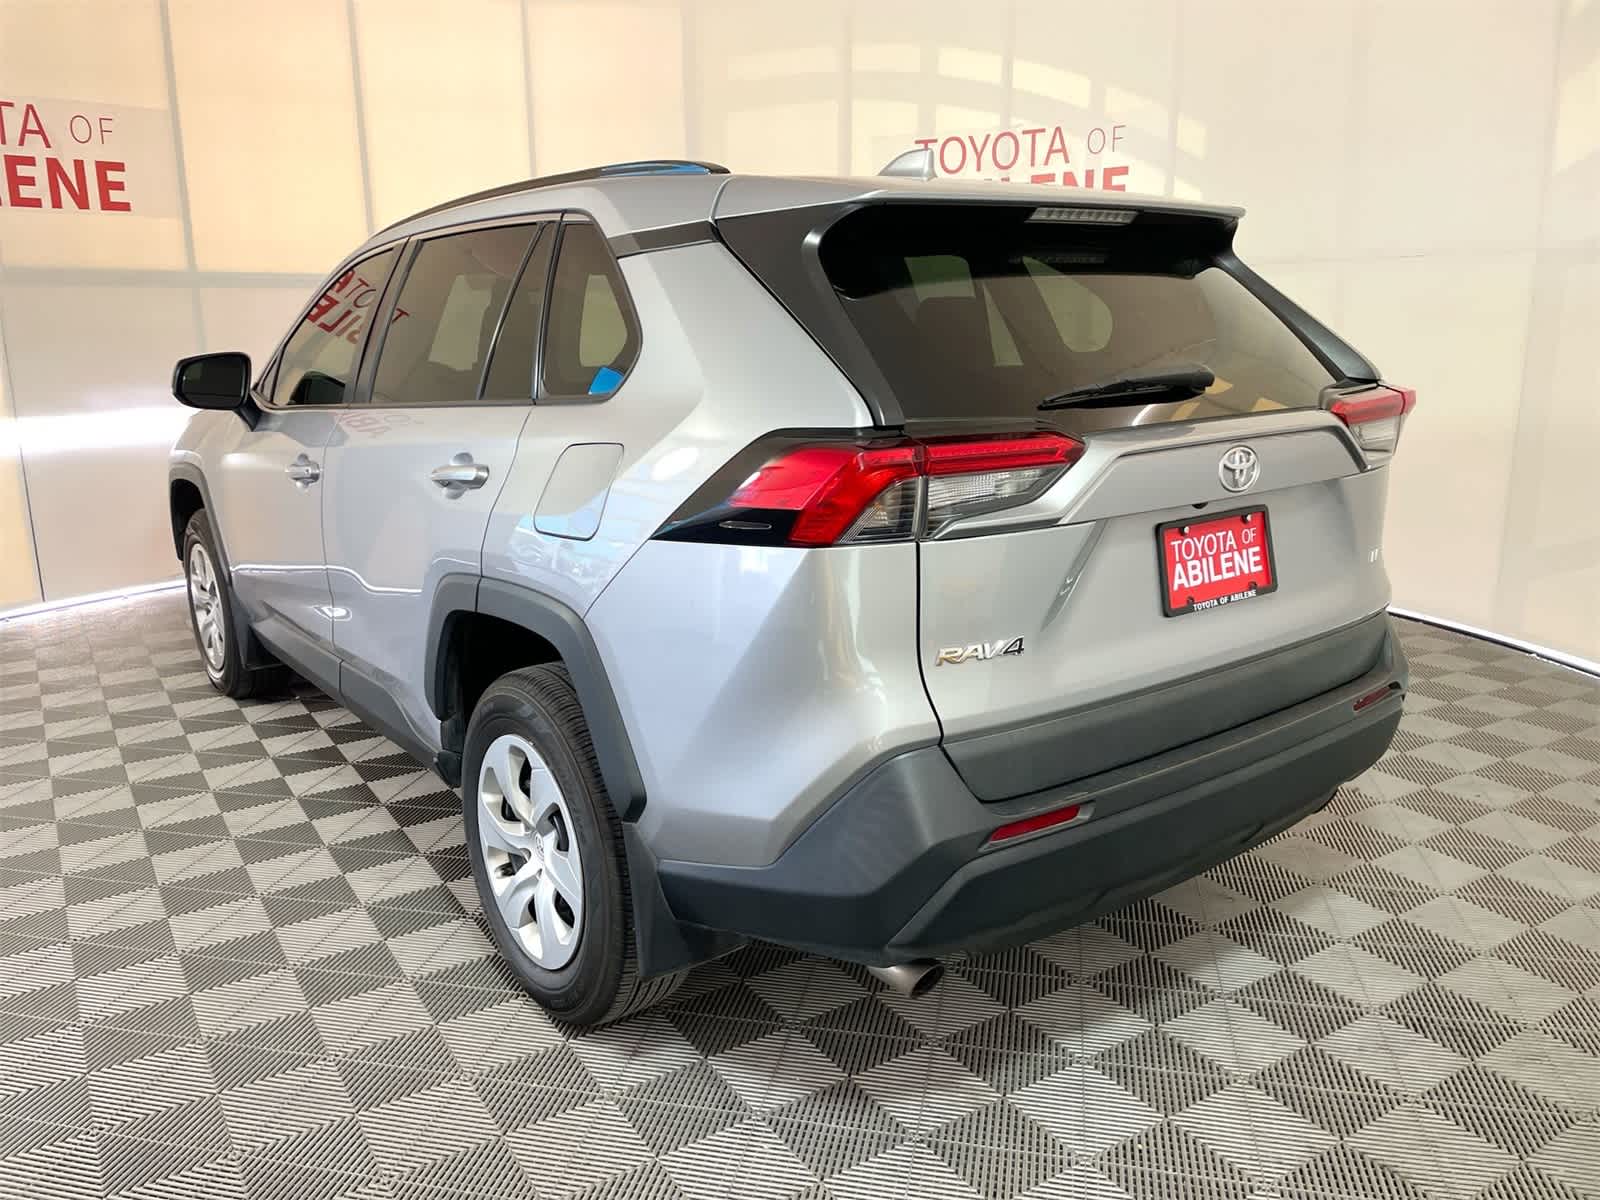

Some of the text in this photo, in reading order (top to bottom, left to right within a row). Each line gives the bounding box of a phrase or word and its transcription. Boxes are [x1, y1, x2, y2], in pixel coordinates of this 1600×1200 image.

[69, 115, 113, 145] OF
[1087, 125, 1126, 155] OF
[0, 154, 132, 212] ENE
[1170, 528, 1257, 562] TOYOTA OF
[1173, 546, 1263, 591] ABILENE
[1193, 590, 1256, 611] TOYOTA OF ABILENE
[936, 635, 1025, 667] RAV4
